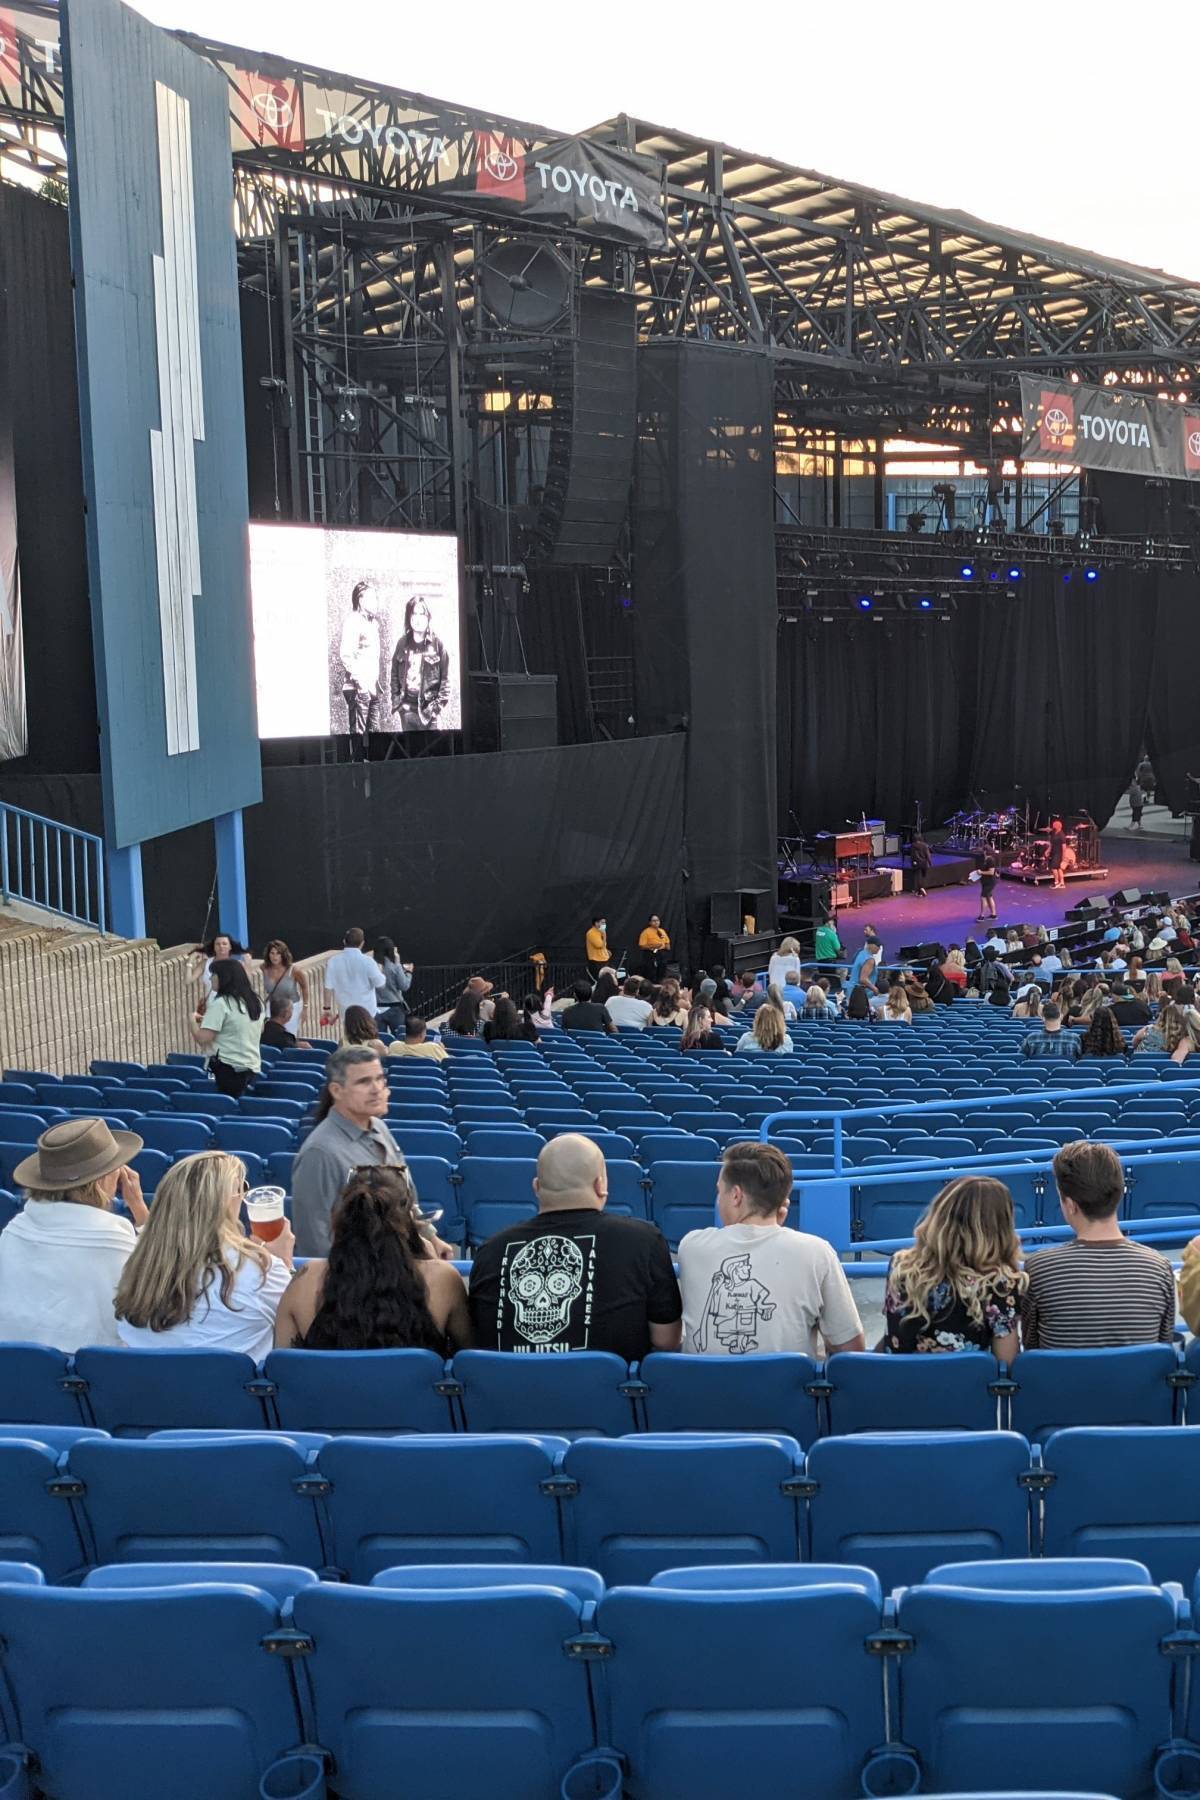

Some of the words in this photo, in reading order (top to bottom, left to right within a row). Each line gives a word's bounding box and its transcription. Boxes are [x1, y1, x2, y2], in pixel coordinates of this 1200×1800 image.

[315, 107, 450, 167] TOYOTA
[534, 161, 639, 213] TOYOTA
[1079, 415, 1151, 448] TOYOTA
[496, 1257, 508, 1329] RICHARD
[584, 1249, 597, 1325] ALVAREZ
